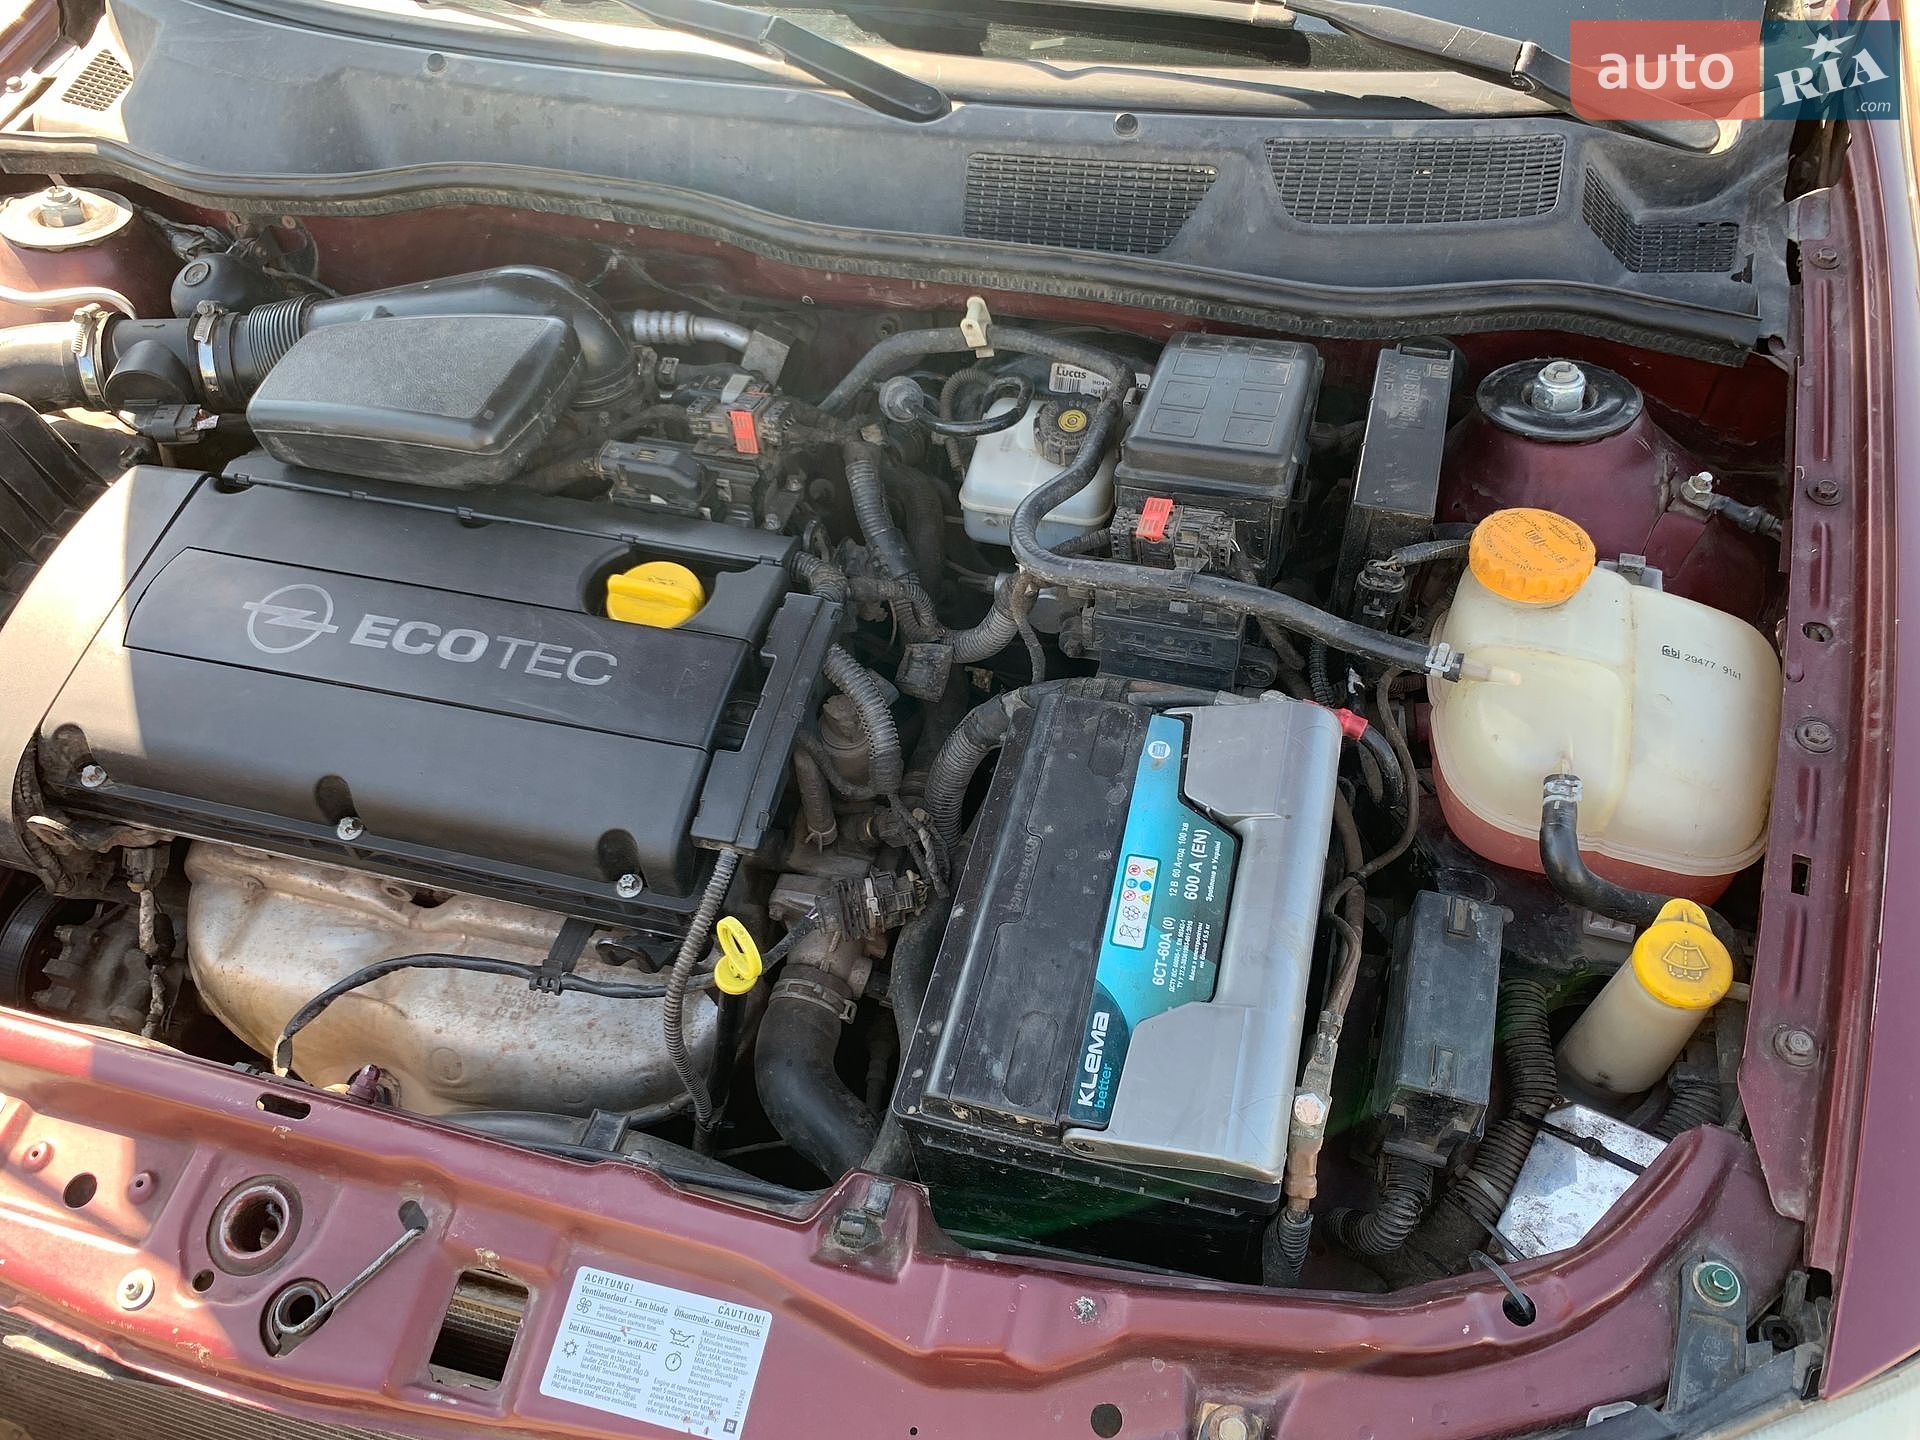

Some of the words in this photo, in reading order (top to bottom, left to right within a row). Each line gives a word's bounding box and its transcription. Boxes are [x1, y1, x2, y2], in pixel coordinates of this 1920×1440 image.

[1056, 366, 1087, 380] Lucas
[1383, 363, 1397, 391] AMP
[349, 613, 618, 686] ECOTEC
[1684, 653, 1717, 670] 29477
[1177, 832, 1186, 844] 100
[1189, 829, 1211, 857] (EN)
[1171, 869, 1180, 877] 60
[1188, 861, 1203, 872] A
[1168, 887, 1177, 896] 12
[1183, 875, 1200, 899] 600
[1094, 1062, 1113, 1109] better
[584, 1272, 634, 1292] ACHTUNG!
[580, 1285, 627, 1303] Ventilatorlauf
[634, 1298, 648, 1308] Fan
[648, 1302, 668, 1313] blade
[717, 1305, 765, 1324] CAUTION!
[568, 1322, 579, 1331] bei
[579, 1325, 622, 1344] Klimaanlage
[627, 1337, 643, 1347] with
[643, 1341, 657, 1351] A/C
[714, 1318, 724, 1327] Oil
[723, 1320, 740, 1331] level
[740, 1324, 761, 1337] check
